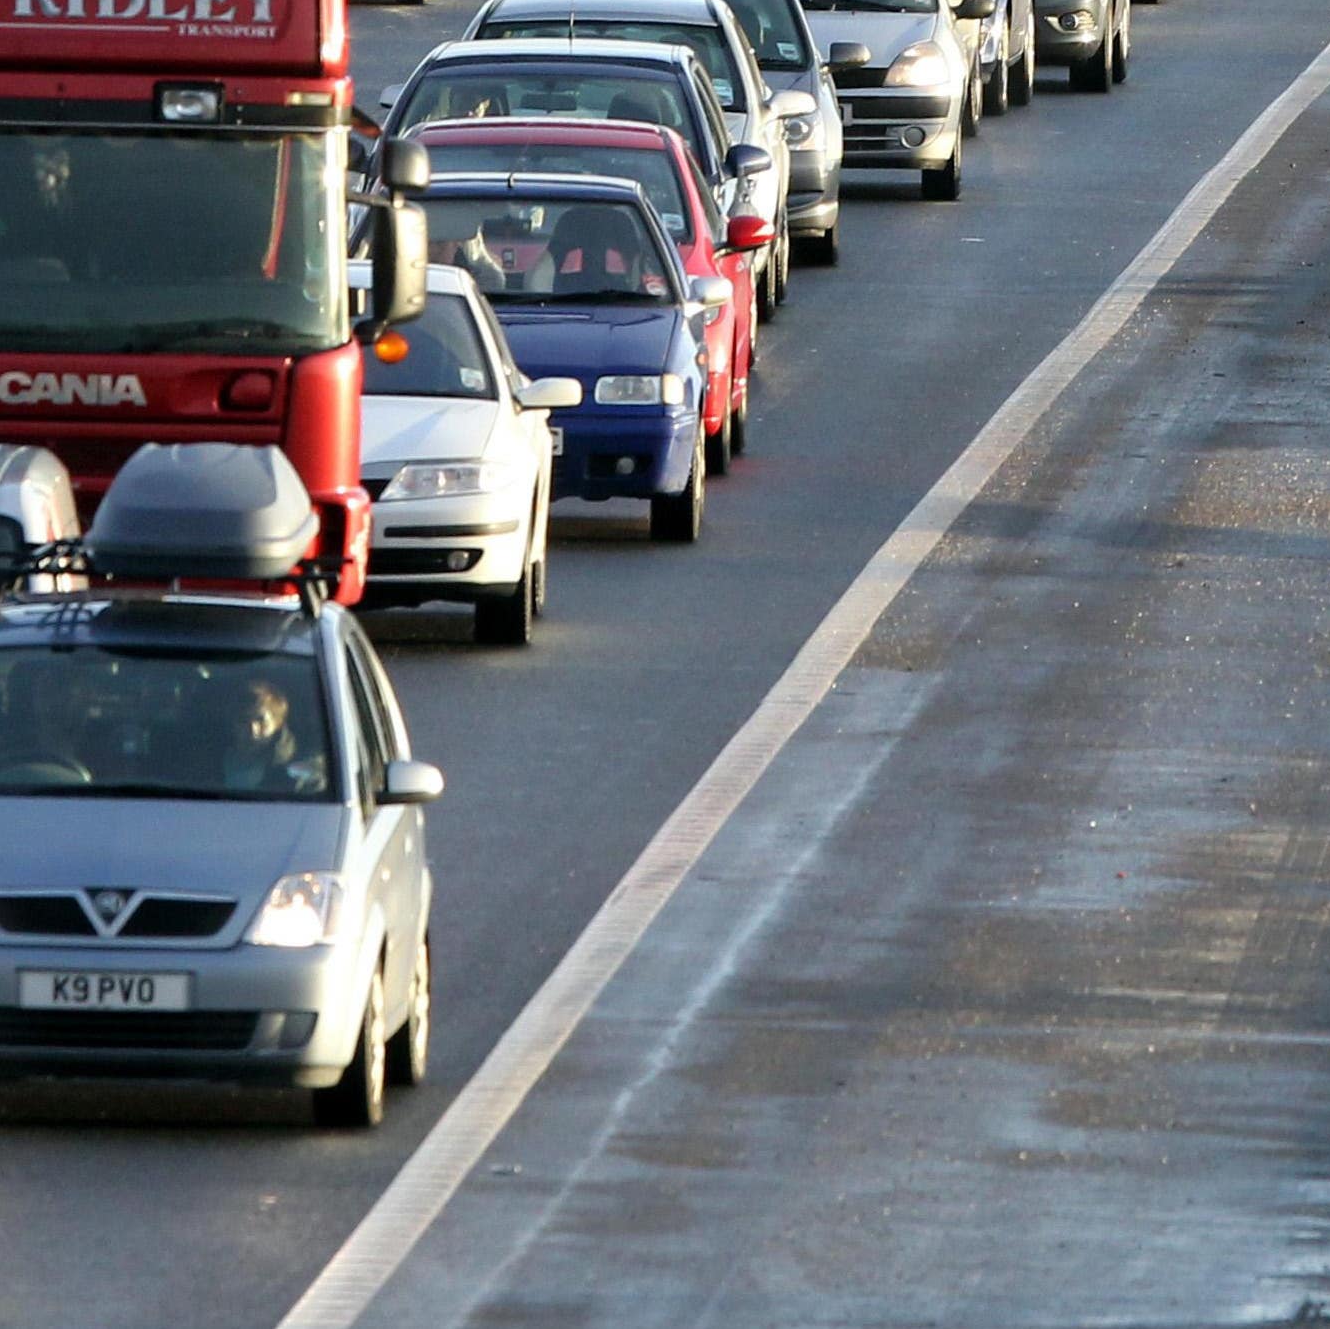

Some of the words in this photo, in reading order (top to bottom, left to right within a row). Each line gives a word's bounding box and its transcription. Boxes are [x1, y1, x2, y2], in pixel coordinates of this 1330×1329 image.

[177, 23, 279, 38] TRANSPORT
[52, 975, 89, 1002] K9
[98, 976, 155, 1003] PVO
